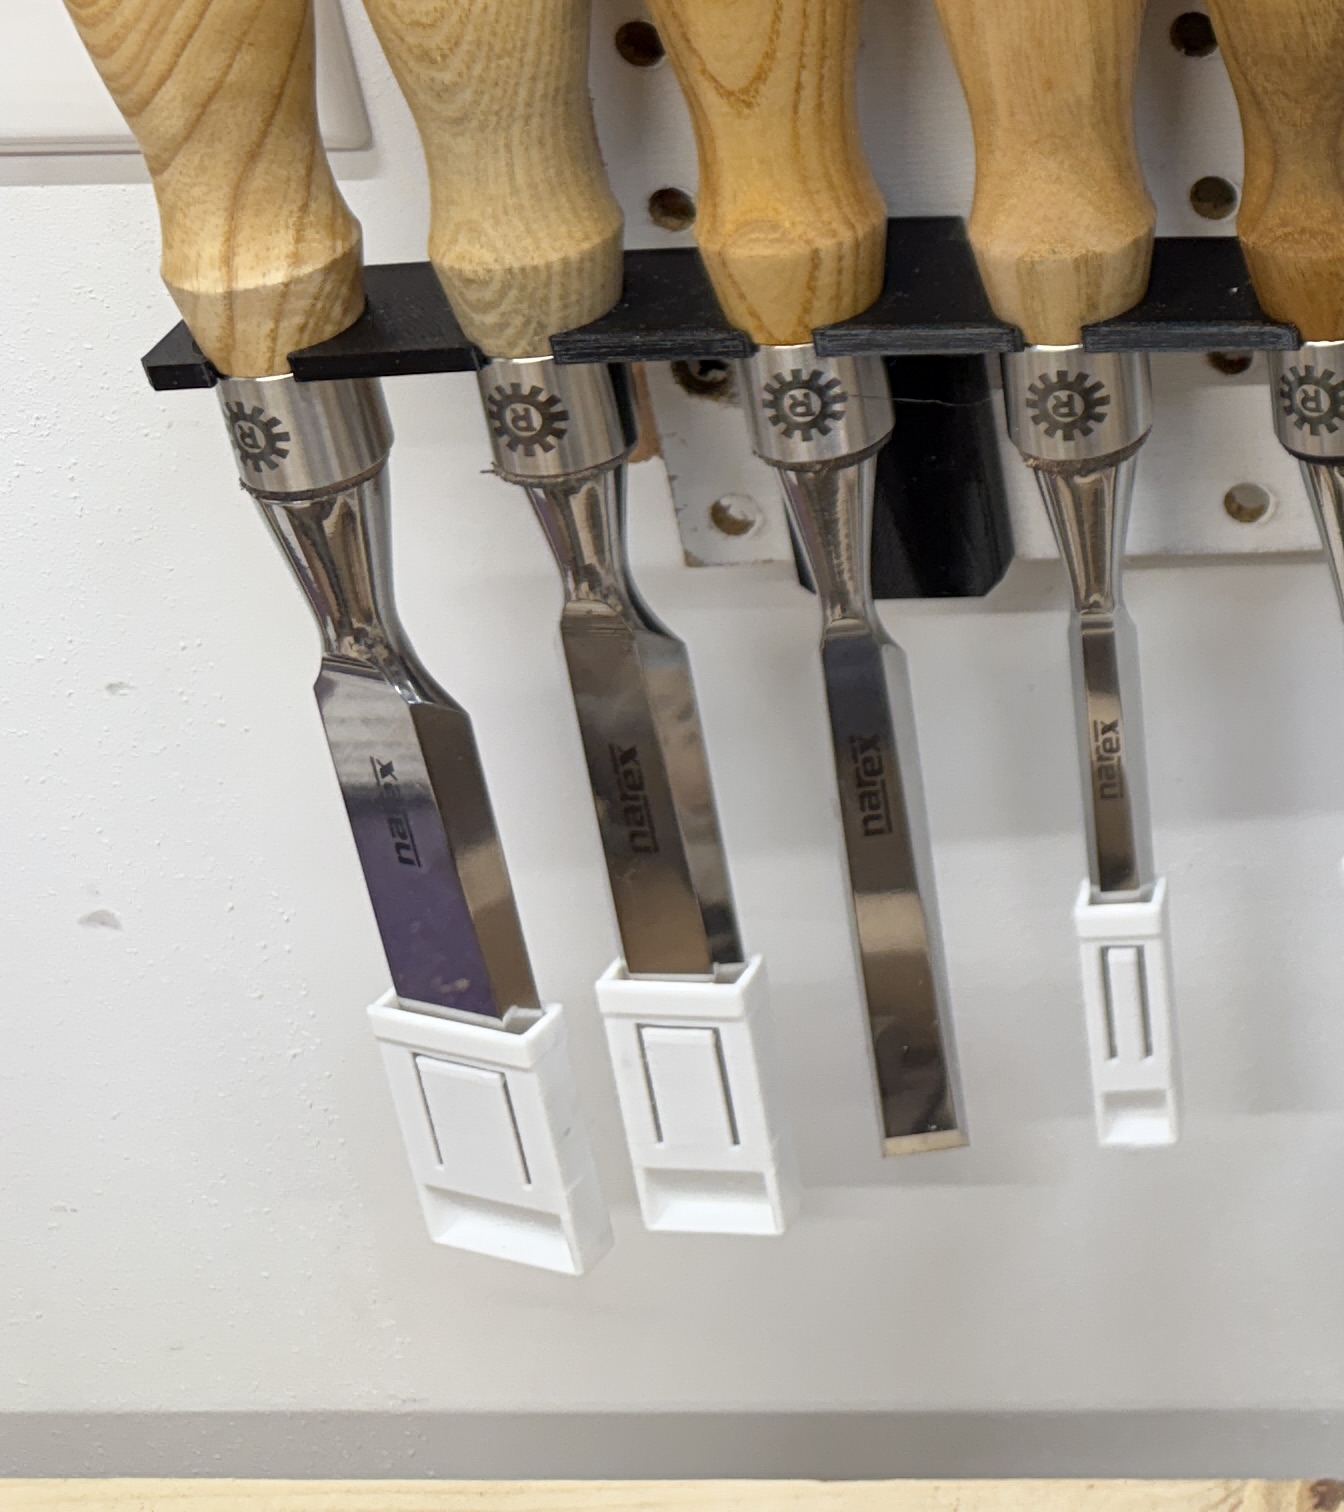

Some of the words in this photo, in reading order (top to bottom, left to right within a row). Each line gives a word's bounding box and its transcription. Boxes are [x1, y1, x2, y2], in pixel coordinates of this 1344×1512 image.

[608, 743, 659, 854] narex
[850, 734, 893, 837] narex
[1095, 719, 1124, 801] narex
